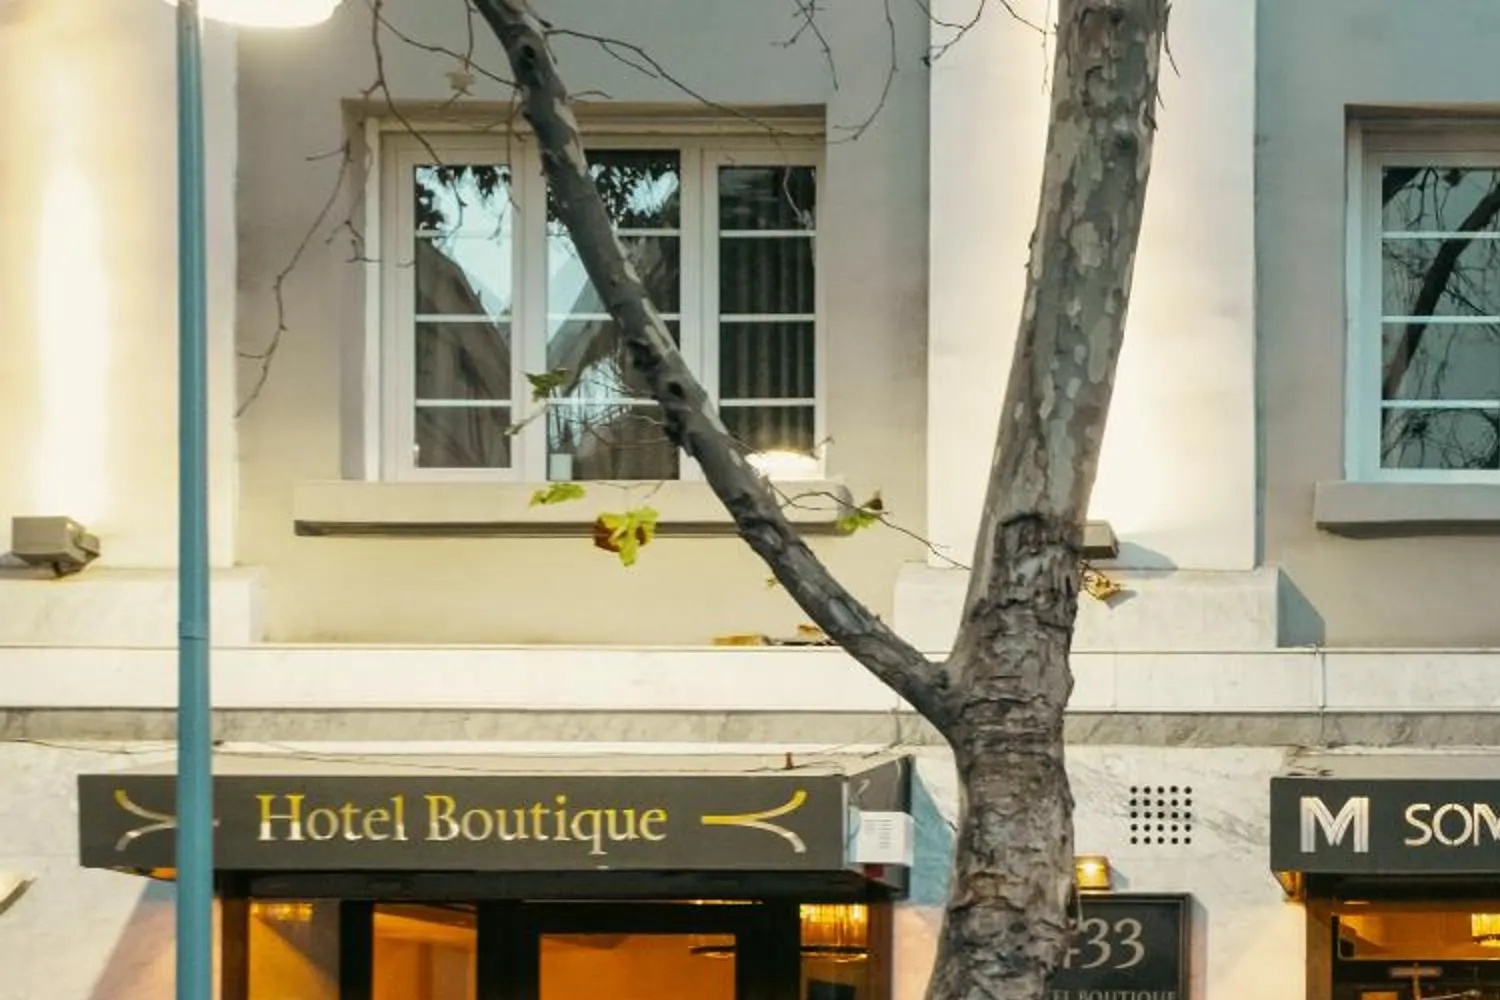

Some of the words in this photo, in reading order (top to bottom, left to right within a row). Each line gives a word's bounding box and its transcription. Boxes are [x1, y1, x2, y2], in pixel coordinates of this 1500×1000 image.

[256, 793, 408, 841] Hotel
[424, 793, 668, 855] Boutique
[1300, 796, 1369, 853] M
